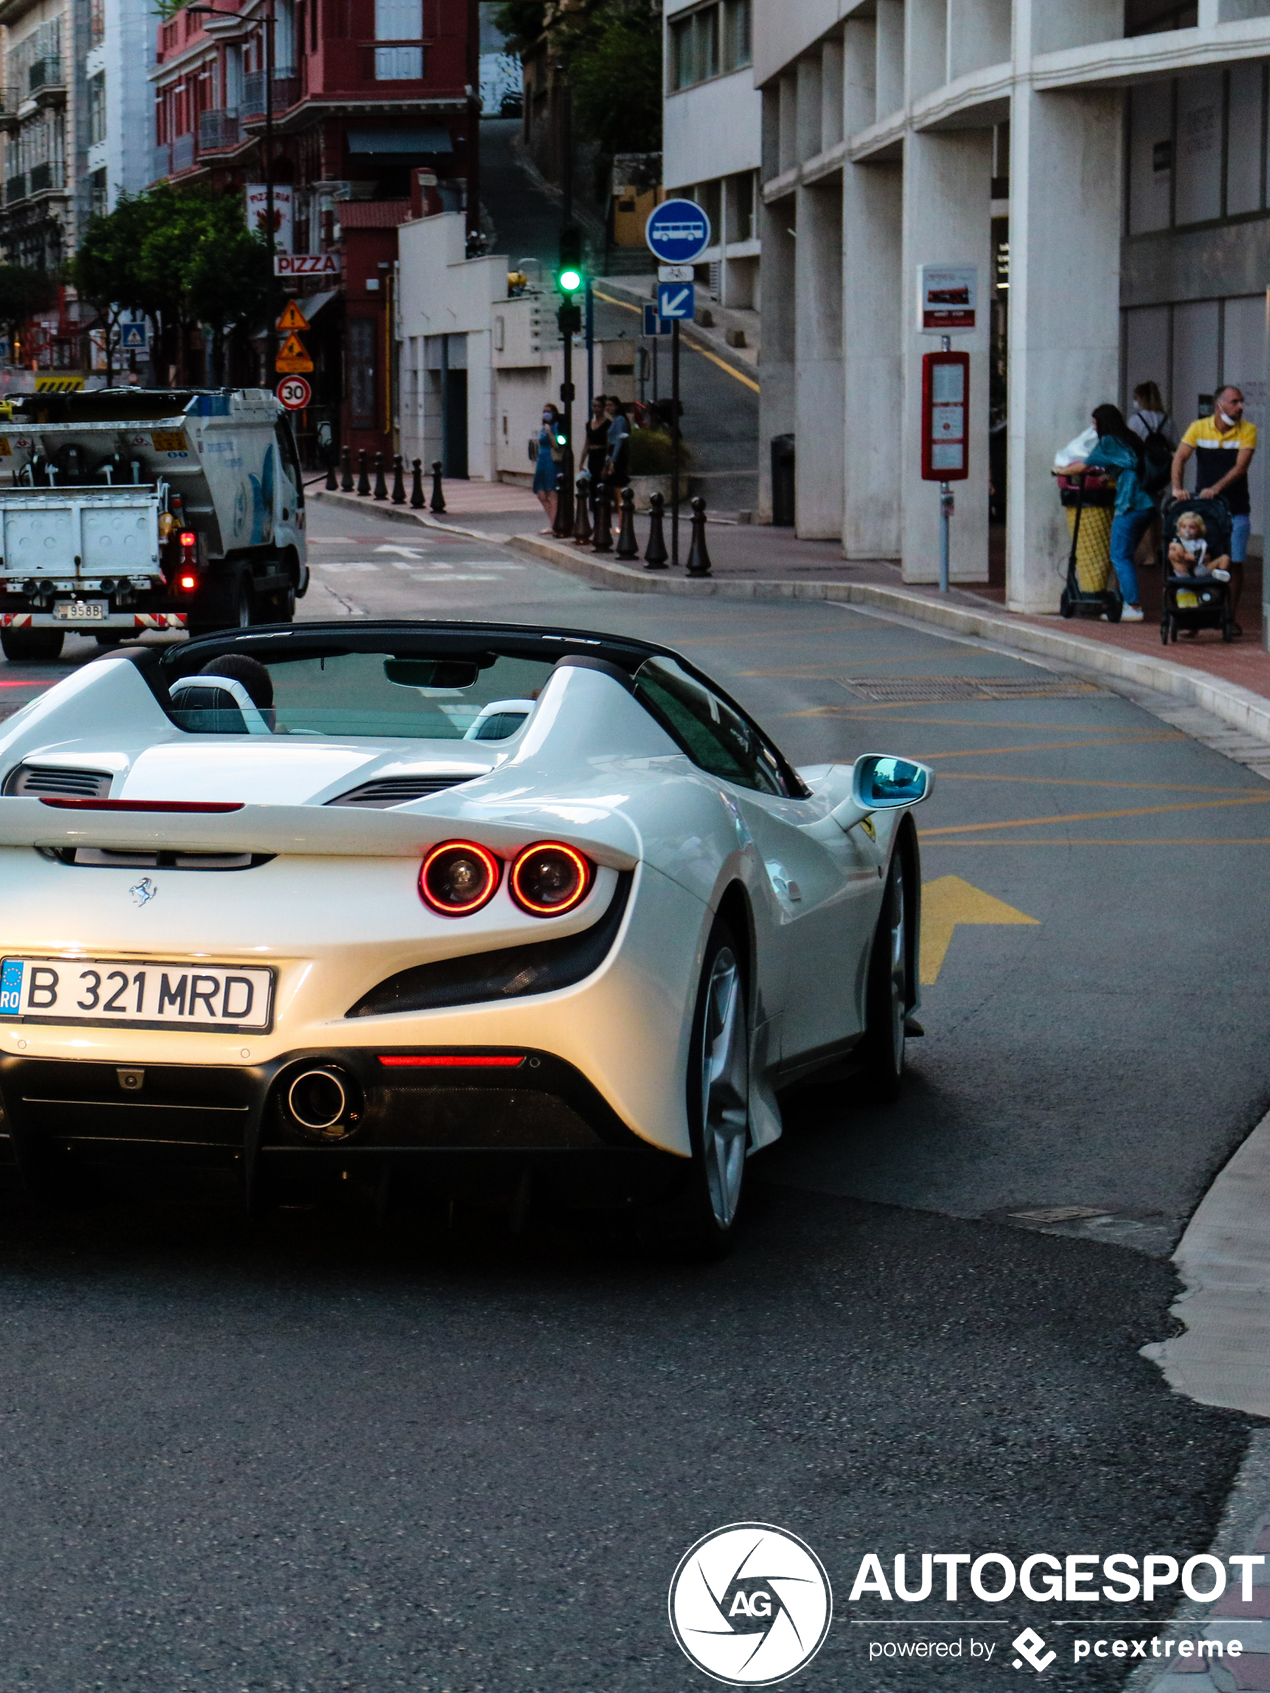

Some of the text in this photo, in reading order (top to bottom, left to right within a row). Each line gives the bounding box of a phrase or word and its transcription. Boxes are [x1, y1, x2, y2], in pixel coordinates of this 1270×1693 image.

[278, 256, 337, 273] PIZZA
[284, 386, 304, 399] 30
[71, 606, 100, 616] 958B
[0, 967, 254, 1018] RO B 321 MRD
